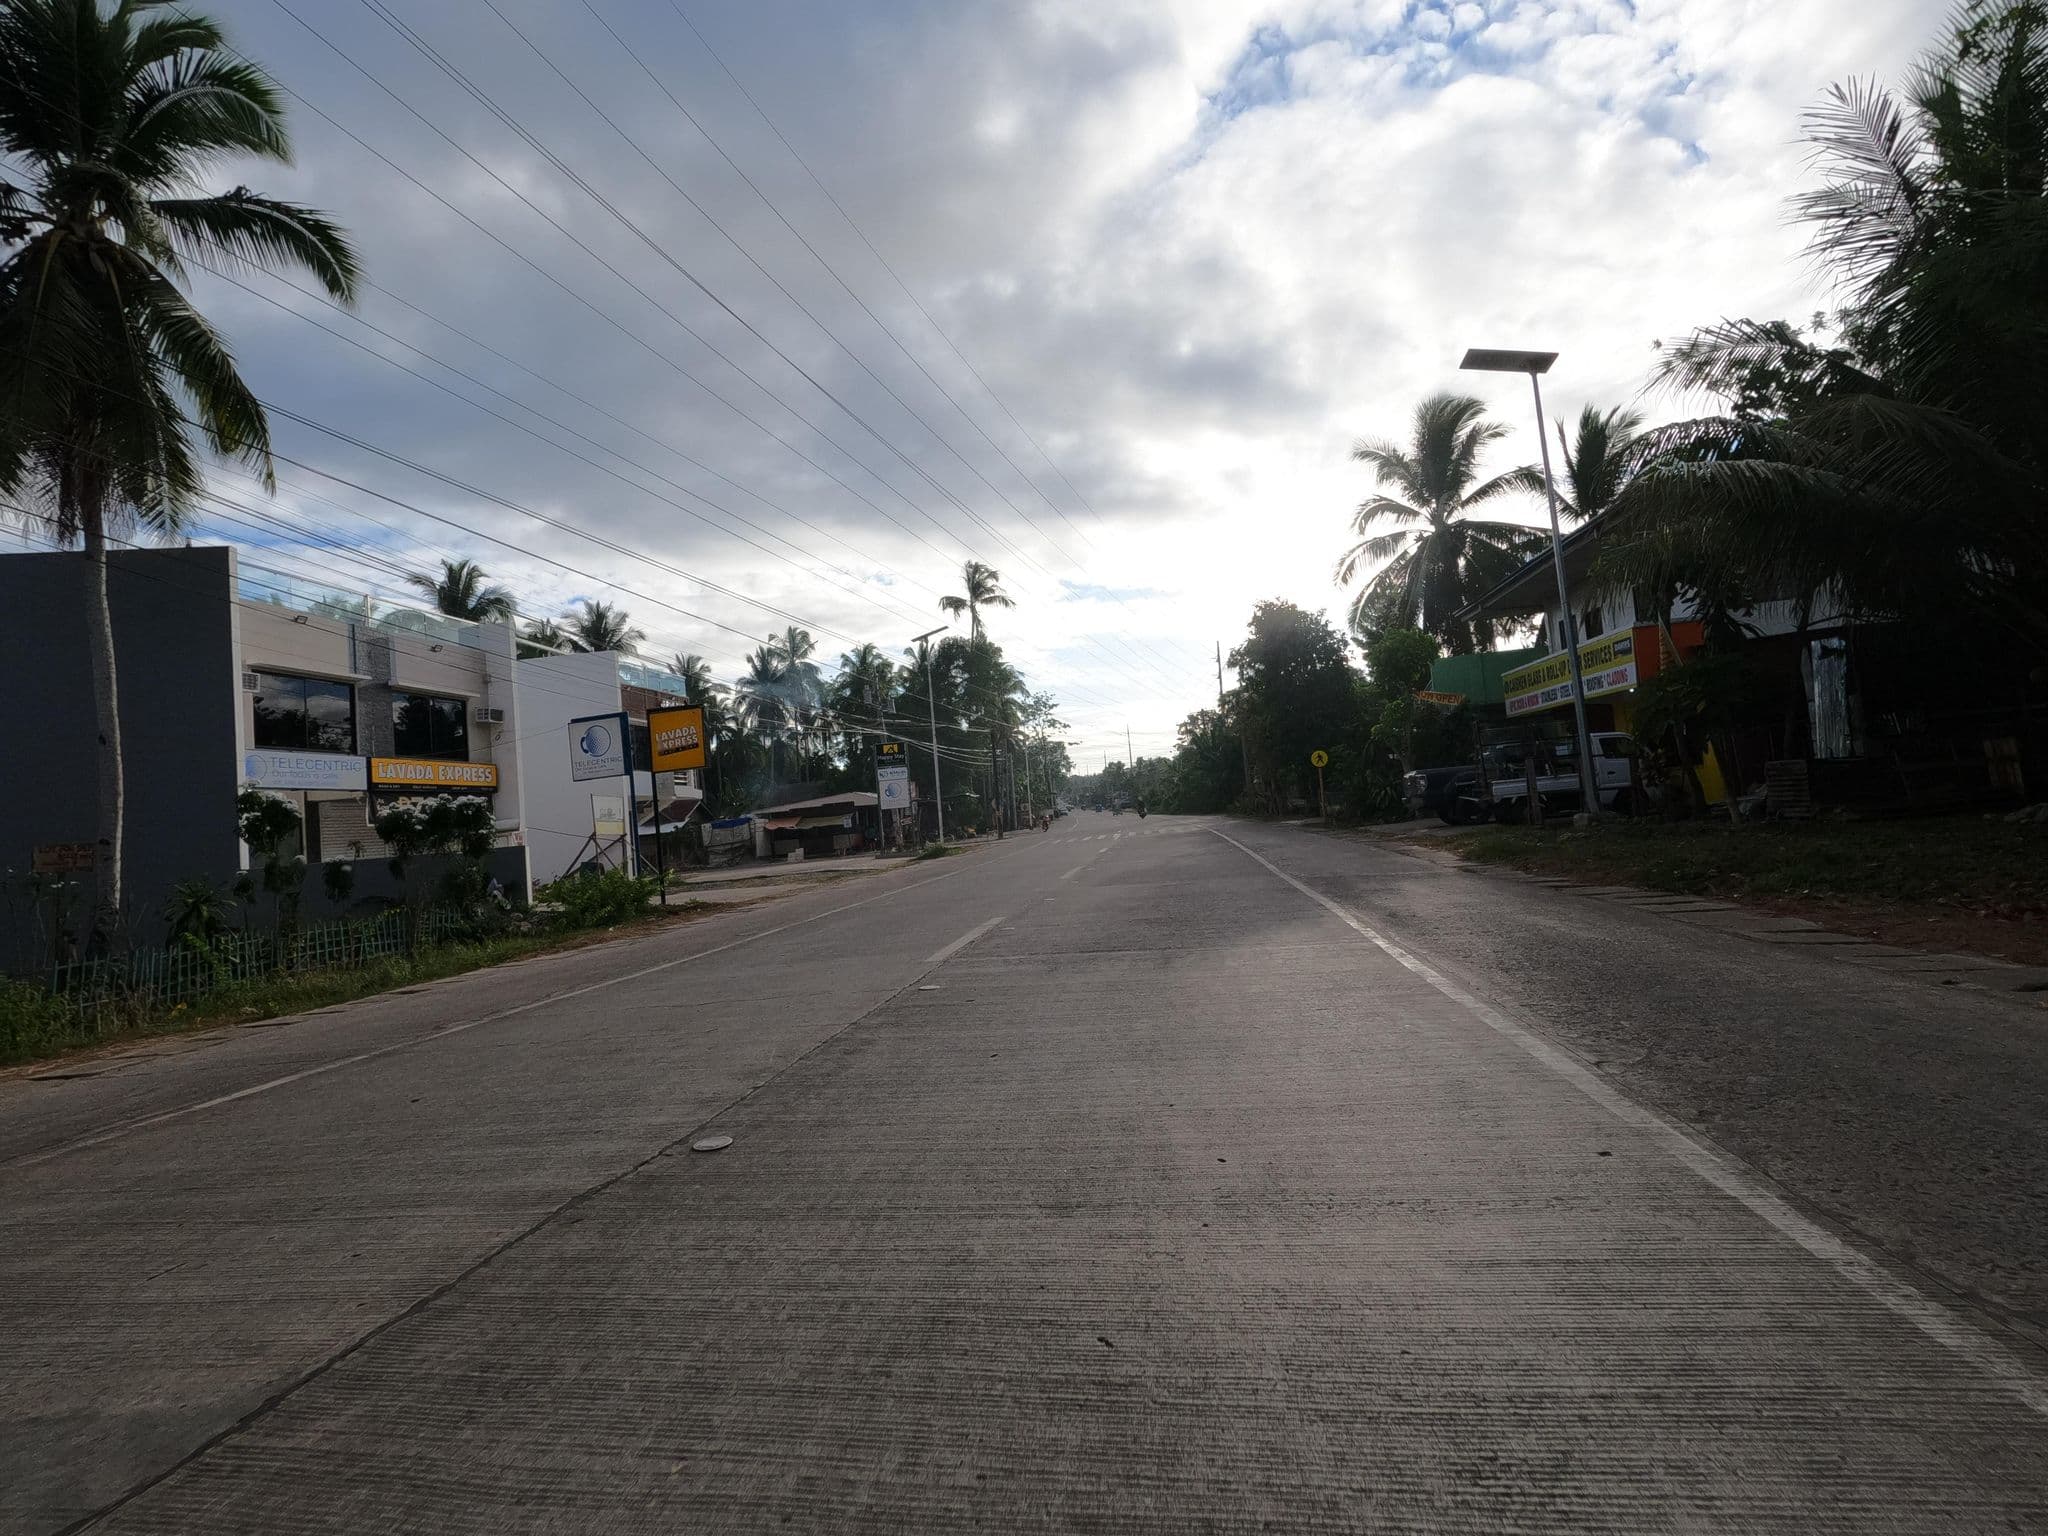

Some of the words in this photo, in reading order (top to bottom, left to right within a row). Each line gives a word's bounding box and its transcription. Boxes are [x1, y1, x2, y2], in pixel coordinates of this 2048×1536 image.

[1583, 644, 1612, 669] SERVICES
[270, 756, 361, 772] TELECENTRIC
[378, 763, 434, 780] LAVADA
[438, 765, 493, 782] EXPRESS
